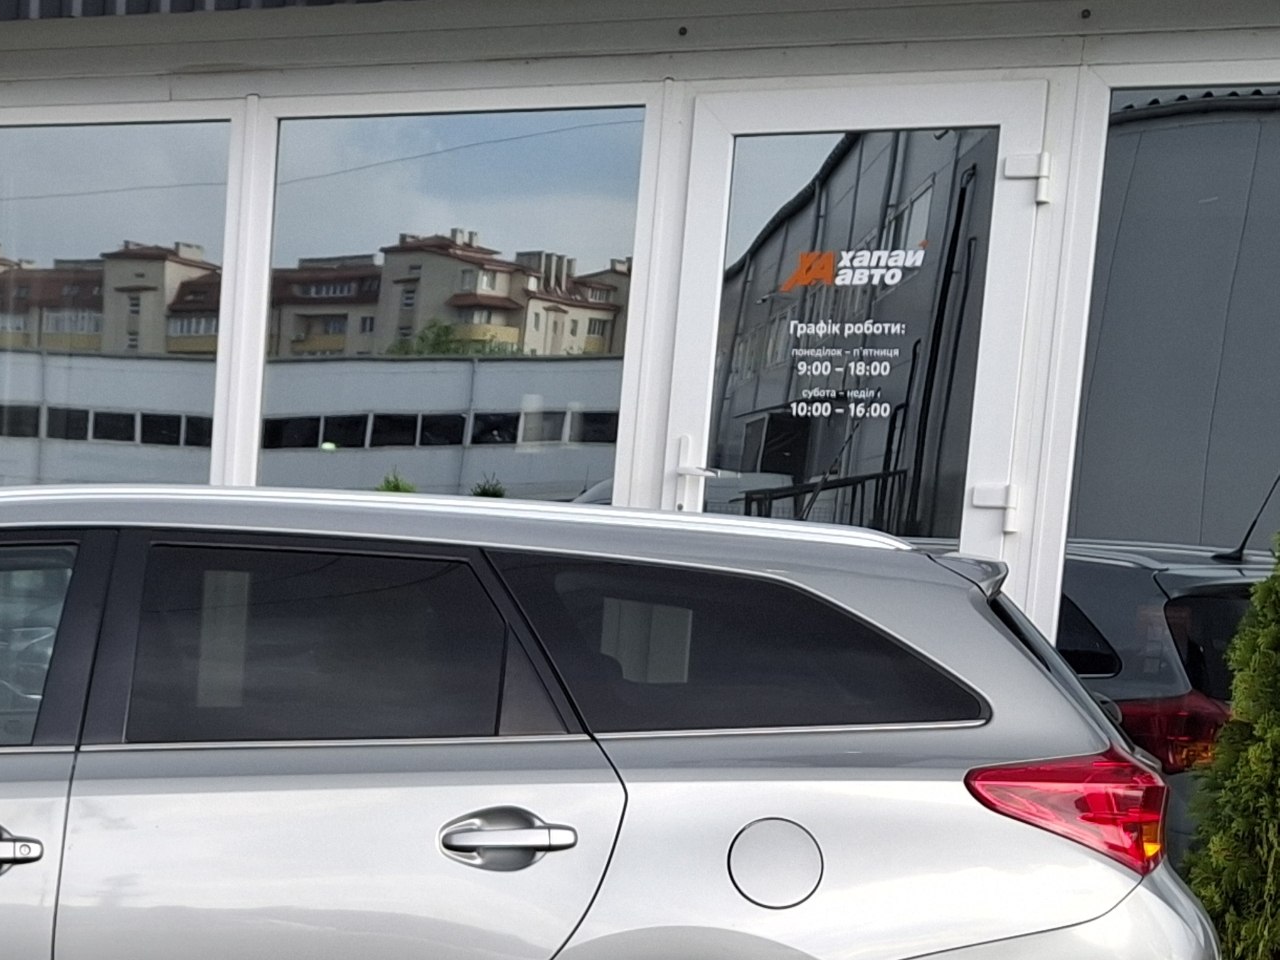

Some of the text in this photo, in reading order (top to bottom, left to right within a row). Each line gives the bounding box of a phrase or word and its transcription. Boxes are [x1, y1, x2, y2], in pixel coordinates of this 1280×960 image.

[837, 240, 928, 267] хапай
[835, 267, 902, 286] авто
[789, 319, 906, 338] Графік роботи:
[791, 346, 842, 358] понеділок
[797, 361, 831, 376] 9:00
[848, 361, 891, 376] 18:00
[802, 387, 836, 399] субота
[790, 402, 831, 417] 10:00
[848, 402, 891, 417] 16:00
